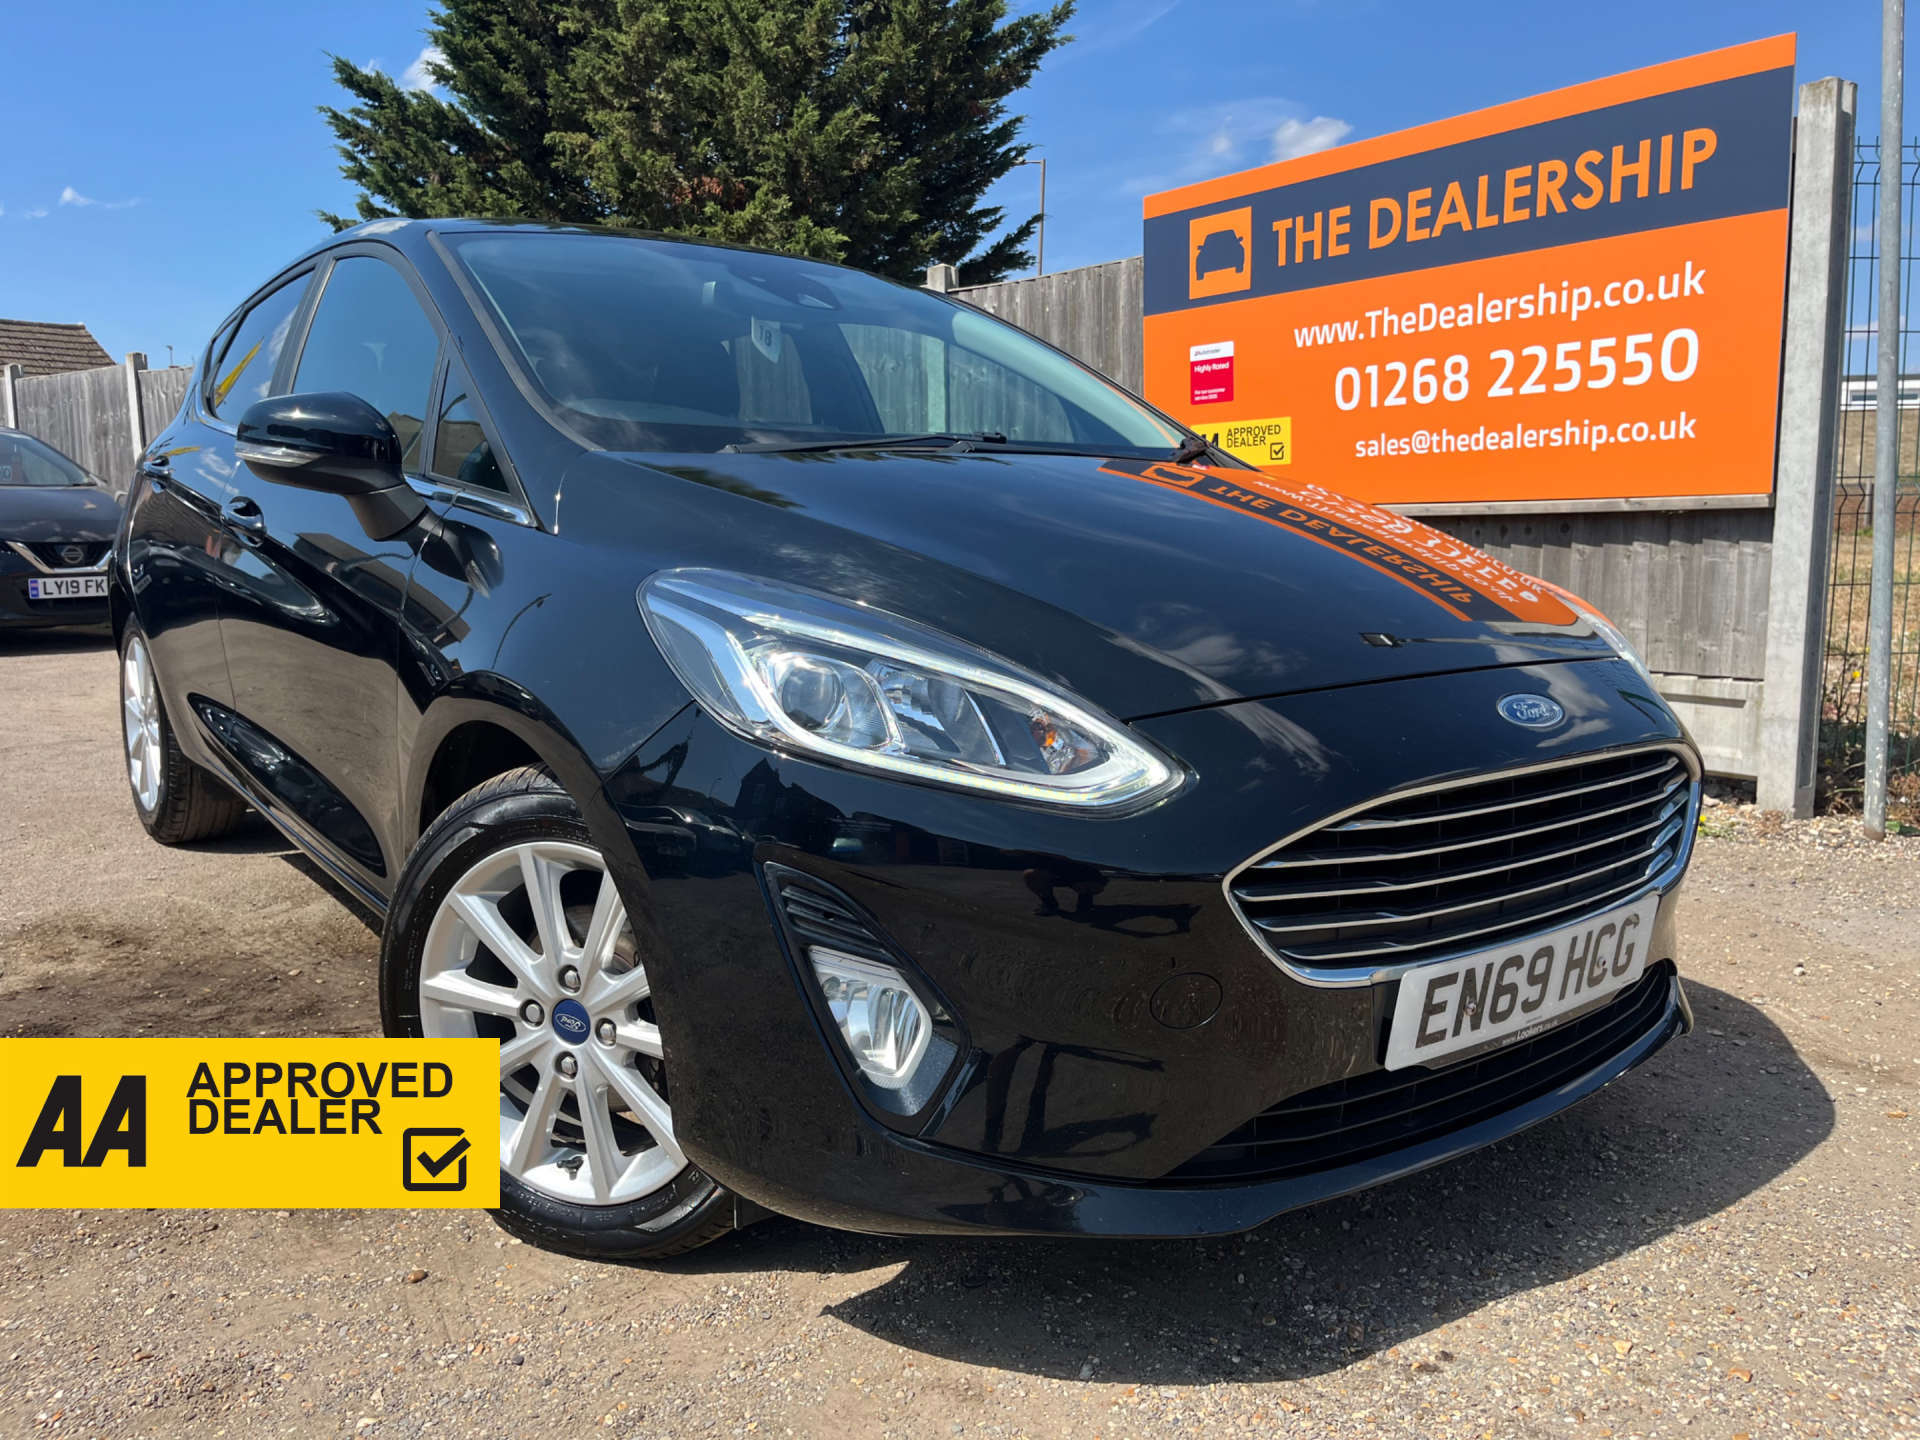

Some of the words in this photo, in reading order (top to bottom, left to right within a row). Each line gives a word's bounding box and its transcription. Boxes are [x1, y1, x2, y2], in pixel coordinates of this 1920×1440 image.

[1272, 204, 1351, 267] THE
[1368, 127, 1718, 251] DEALERSHIP
[1294, 260, 1706, 348] www.TheDealership.co.uk
[1334, 353, 1470, 412] 01268
[1487, 327, 1700, 398] 225550
[1226, 423, 1281, 439] APPROVED
[1226, 435, 1267, 449] DEALER
[1354, 410, 1698, 459] sales@thedealership.co.uk
[42, 580, 80, 596] LY19
[84, 579, 106, 594] FK
[1414, 944, 1555, 1049] EN69
[1557, 912, 1640, 1002] HCG
